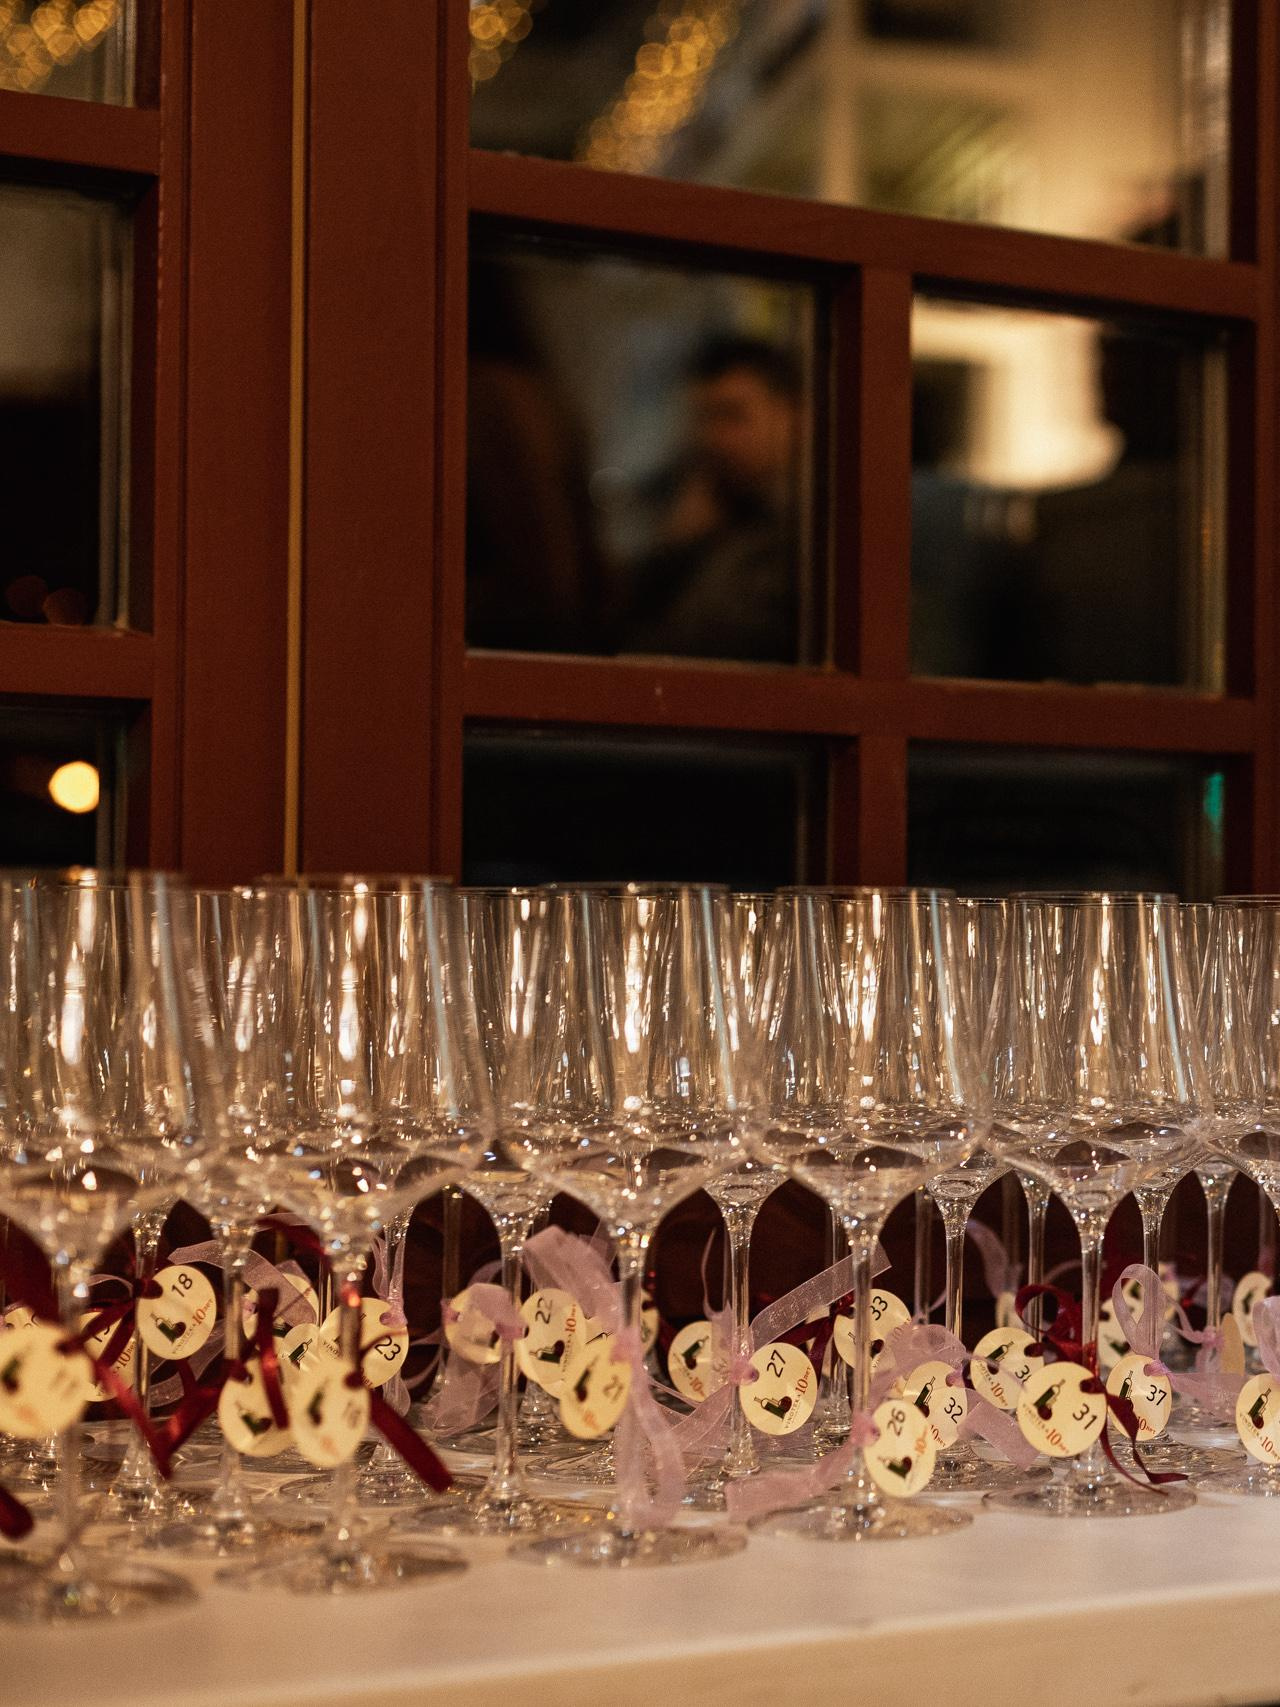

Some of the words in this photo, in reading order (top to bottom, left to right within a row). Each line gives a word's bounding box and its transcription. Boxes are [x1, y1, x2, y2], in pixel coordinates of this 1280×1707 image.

[171, 1273, 193, 1298] 18
[535, 1297, 552, 1324] 22
[870, 1295, 888, 1321] 33
[374, 1335, 401, 1361] 23
[767, 1349, 786, 1378] 27
[1146, 1384, 1168, 1406] 37
[887, 1407, 906, 1437] 26
[944, 1396, 963, 1424] 32
[1072, 1402, 1098, 1430] 31
